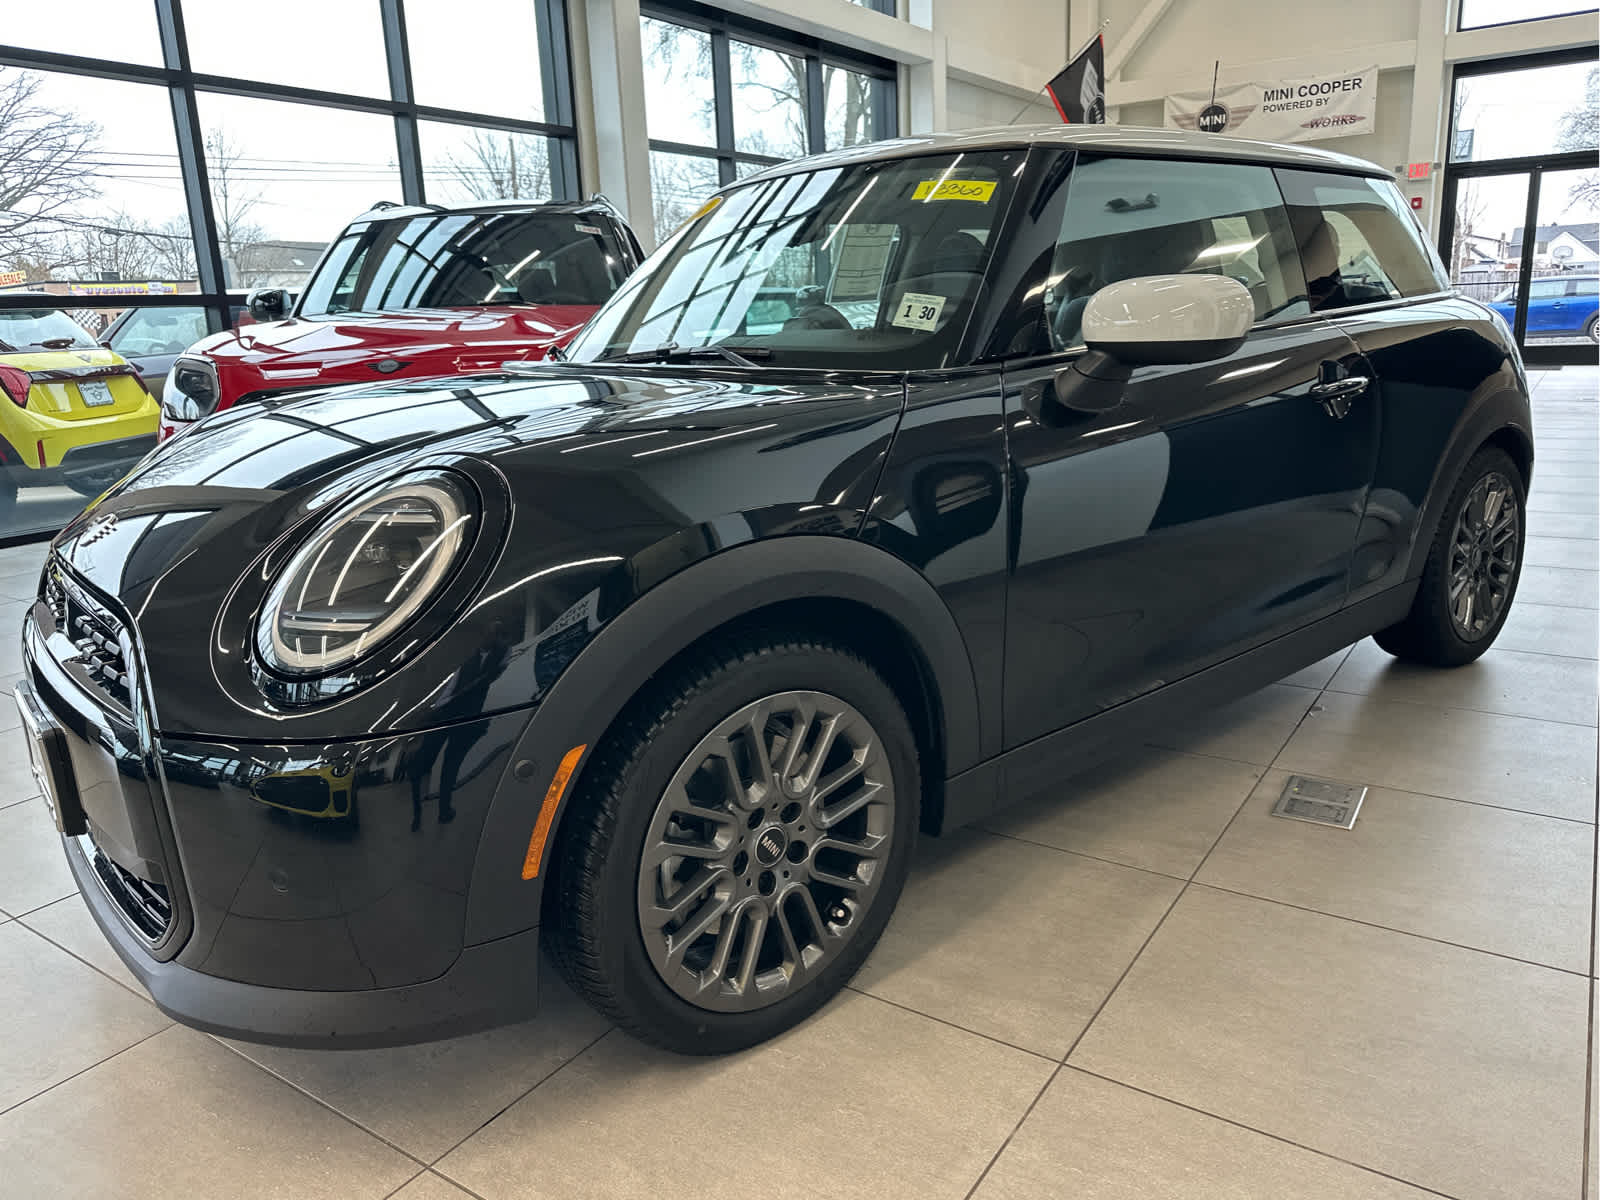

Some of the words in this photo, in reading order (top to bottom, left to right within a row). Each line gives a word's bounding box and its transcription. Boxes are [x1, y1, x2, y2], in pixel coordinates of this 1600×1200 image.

[1263, 87, 1294, 102] MINI
[1298, 78, 1362, 97] COOPER
[1262, 99, 1313, 112] POWERED
[1315, 97, 1330, 107] BY
[1200, 113, 1226, 126] MINI
[1309, 116, 1357, 128] WORKS
[1409, 162, 1431, 178] EXIT
[903, 304, 912, 318] 1
[918, 305, 936, 321] 30
[761, 835, 781, 857] MINI
